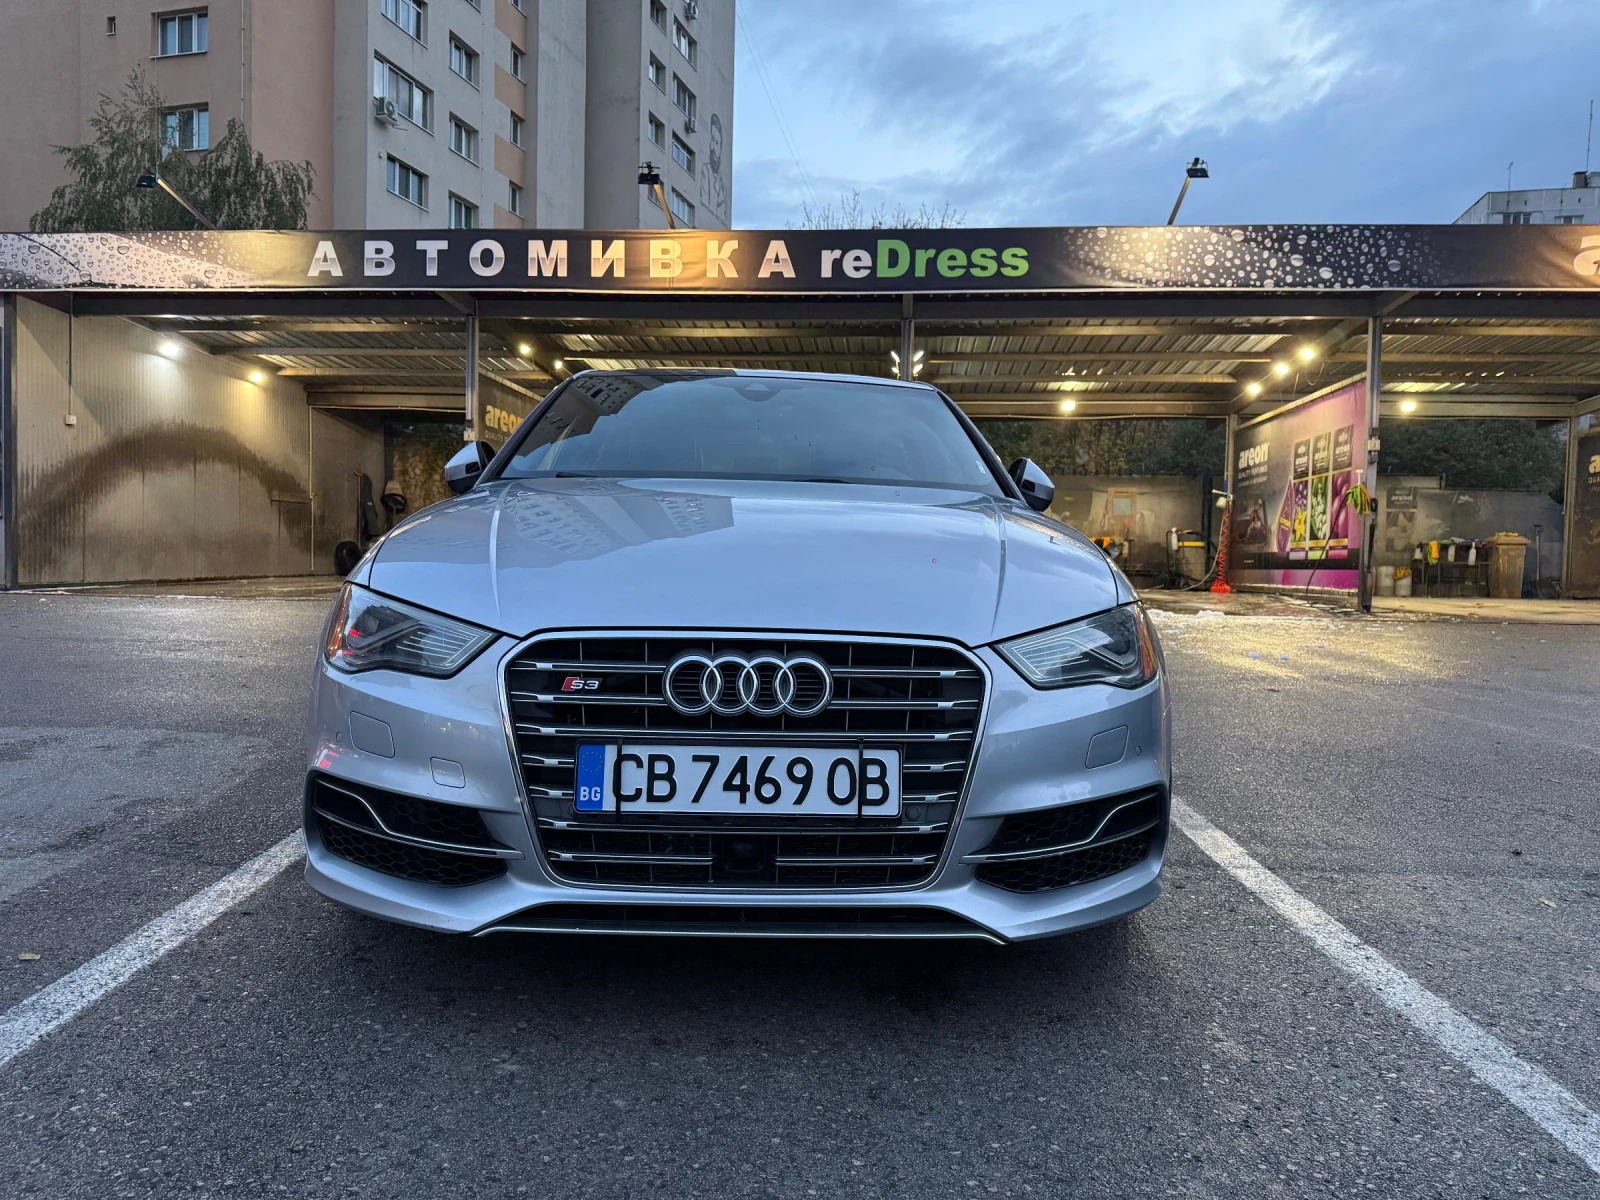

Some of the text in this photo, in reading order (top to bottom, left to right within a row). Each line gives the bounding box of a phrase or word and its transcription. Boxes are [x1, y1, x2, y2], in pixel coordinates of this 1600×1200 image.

[307, 239, 1030, 279] АВТОМИВКА reDress
[1238, 442, 1269, 469] areon
[570, 680, 600, 690] S3
[612, 753, 678, 804] CB
[690, 754, 814, 806] 7469
[579, 786, 601, 802] BG
